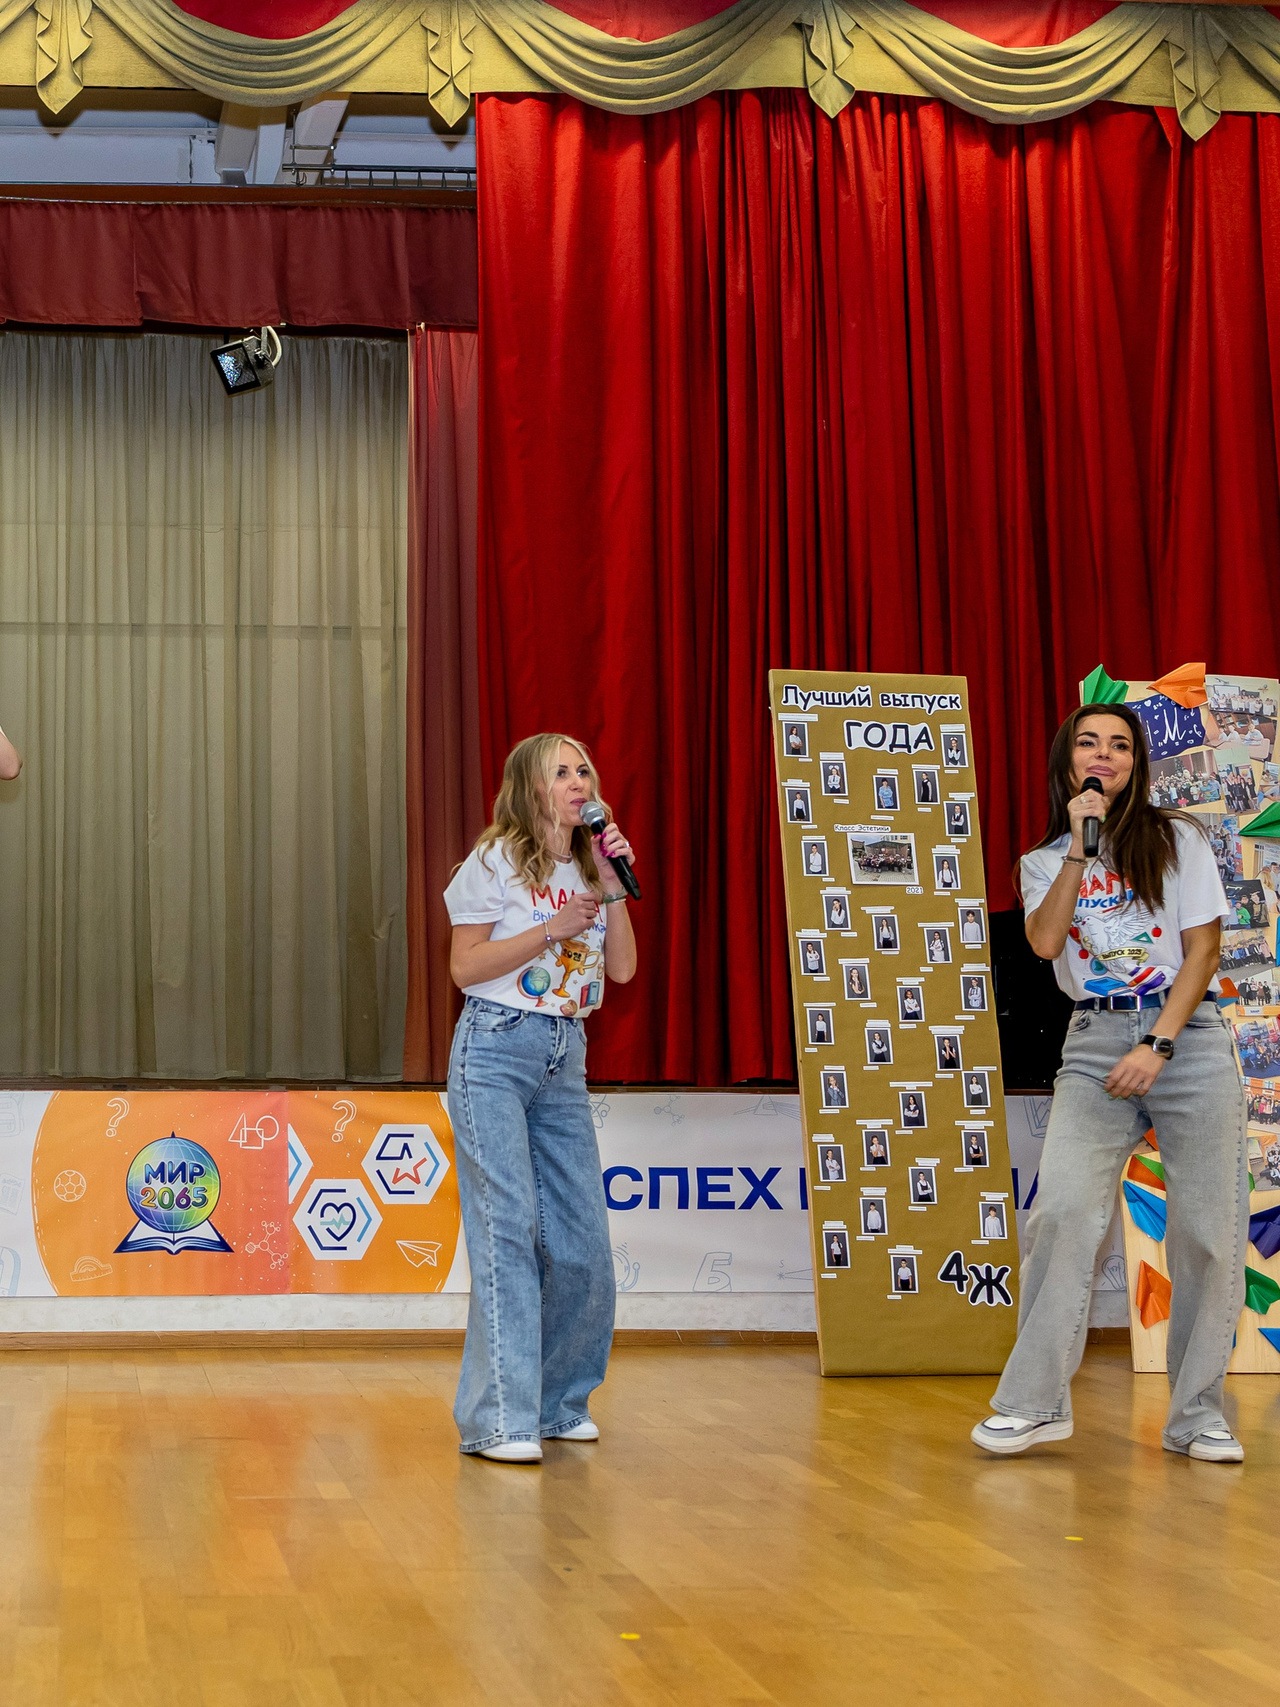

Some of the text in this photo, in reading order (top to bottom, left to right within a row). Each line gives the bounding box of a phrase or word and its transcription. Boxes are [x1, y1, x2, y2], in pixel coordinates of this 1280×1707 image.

[783, 686, 960, 714] Лучший выпуск
[846, 722, 933, 753] ГОДА
[144, 1161, 206, 1184] МИР
[141, 1187, 208, 1209] 2065
[602, 1166, 784, 1211] СПЕХ
[939, 1252, 1013, 1305] 4Ж
